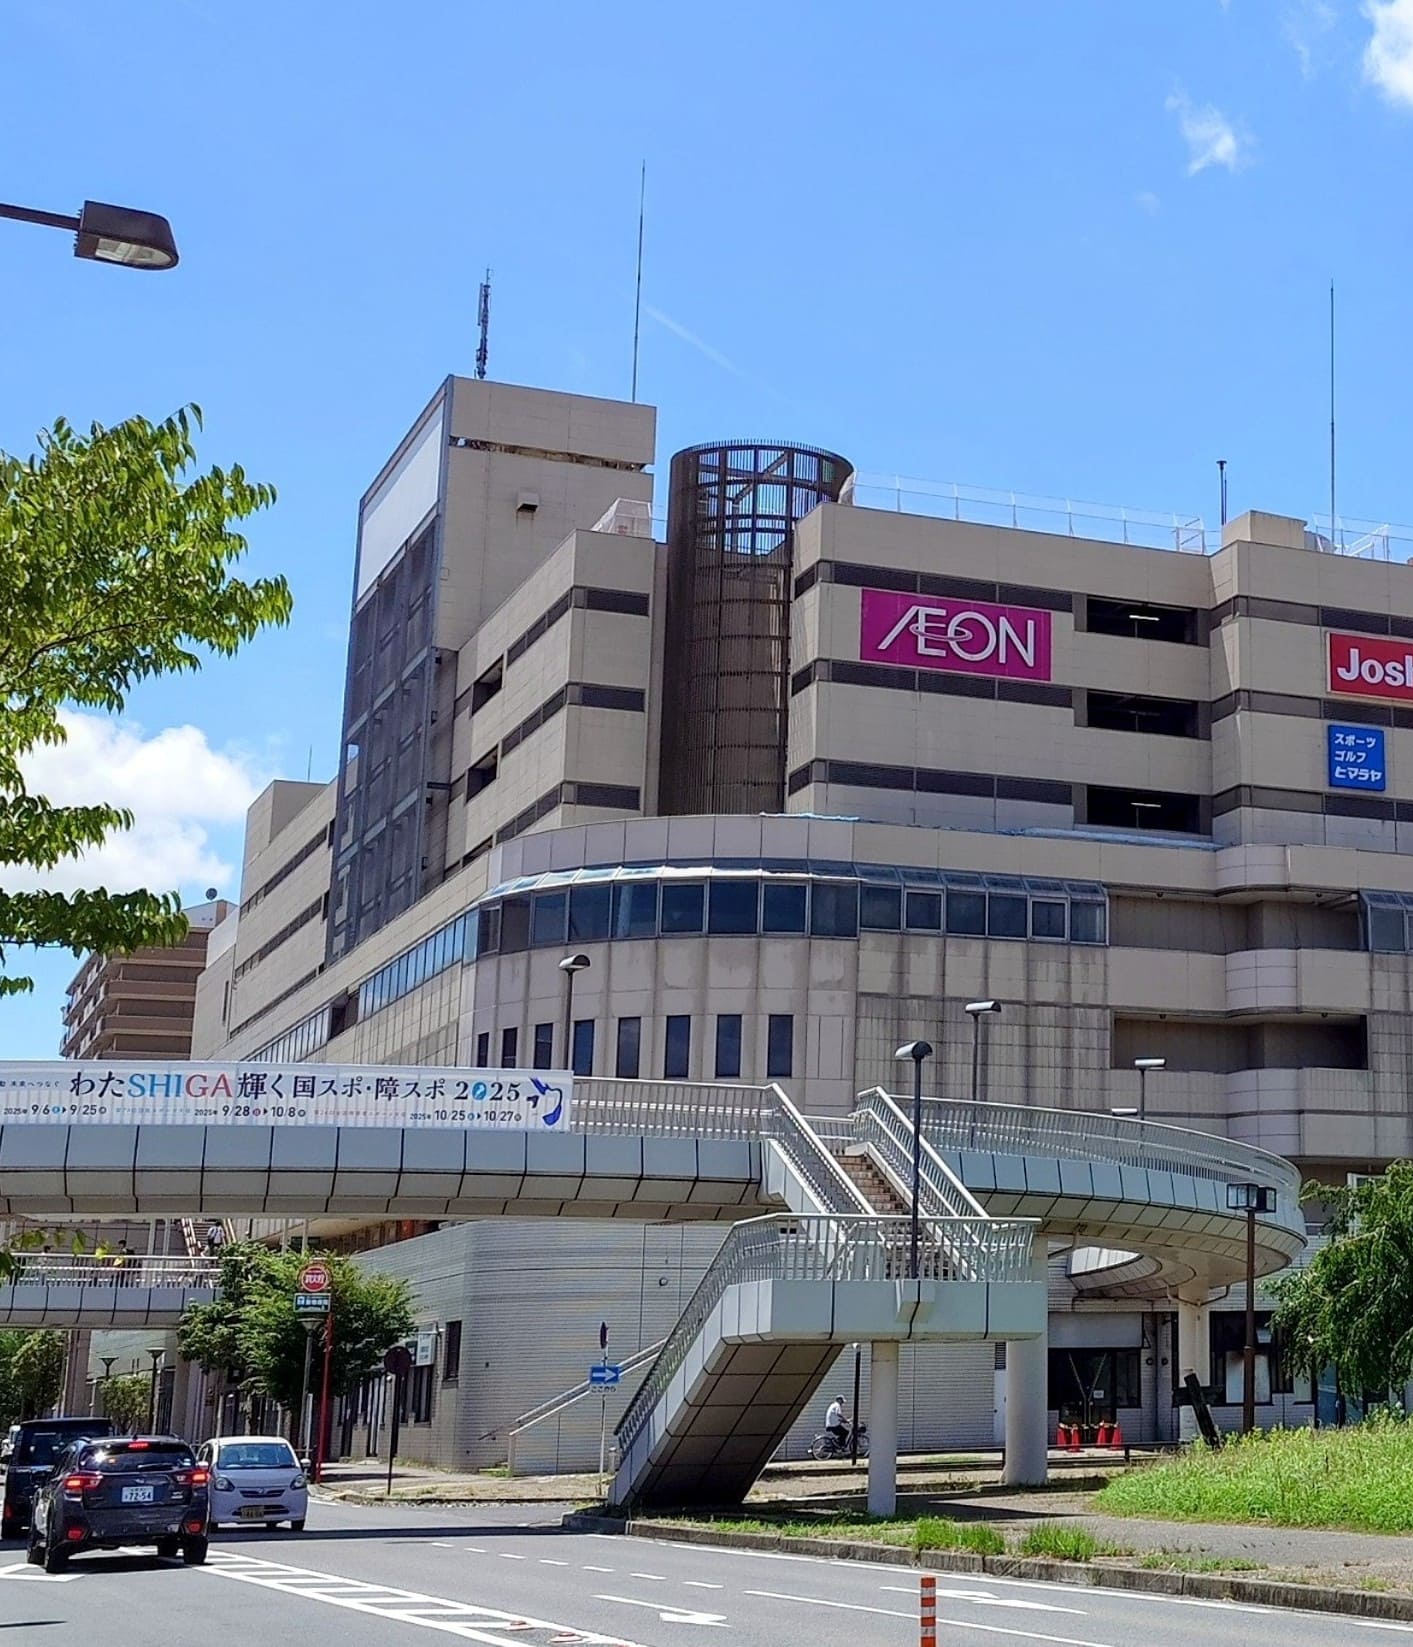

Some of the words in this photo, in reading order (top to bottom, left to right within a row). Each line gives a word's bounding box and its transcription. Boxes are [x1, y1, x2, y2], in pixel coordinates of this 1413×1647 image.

[1334, 733, 1376, 748] スポーツ
[1334, 750, 1367, 763] ゴルフ
[1334, 765, 1383, 782] ヒマラヤ
